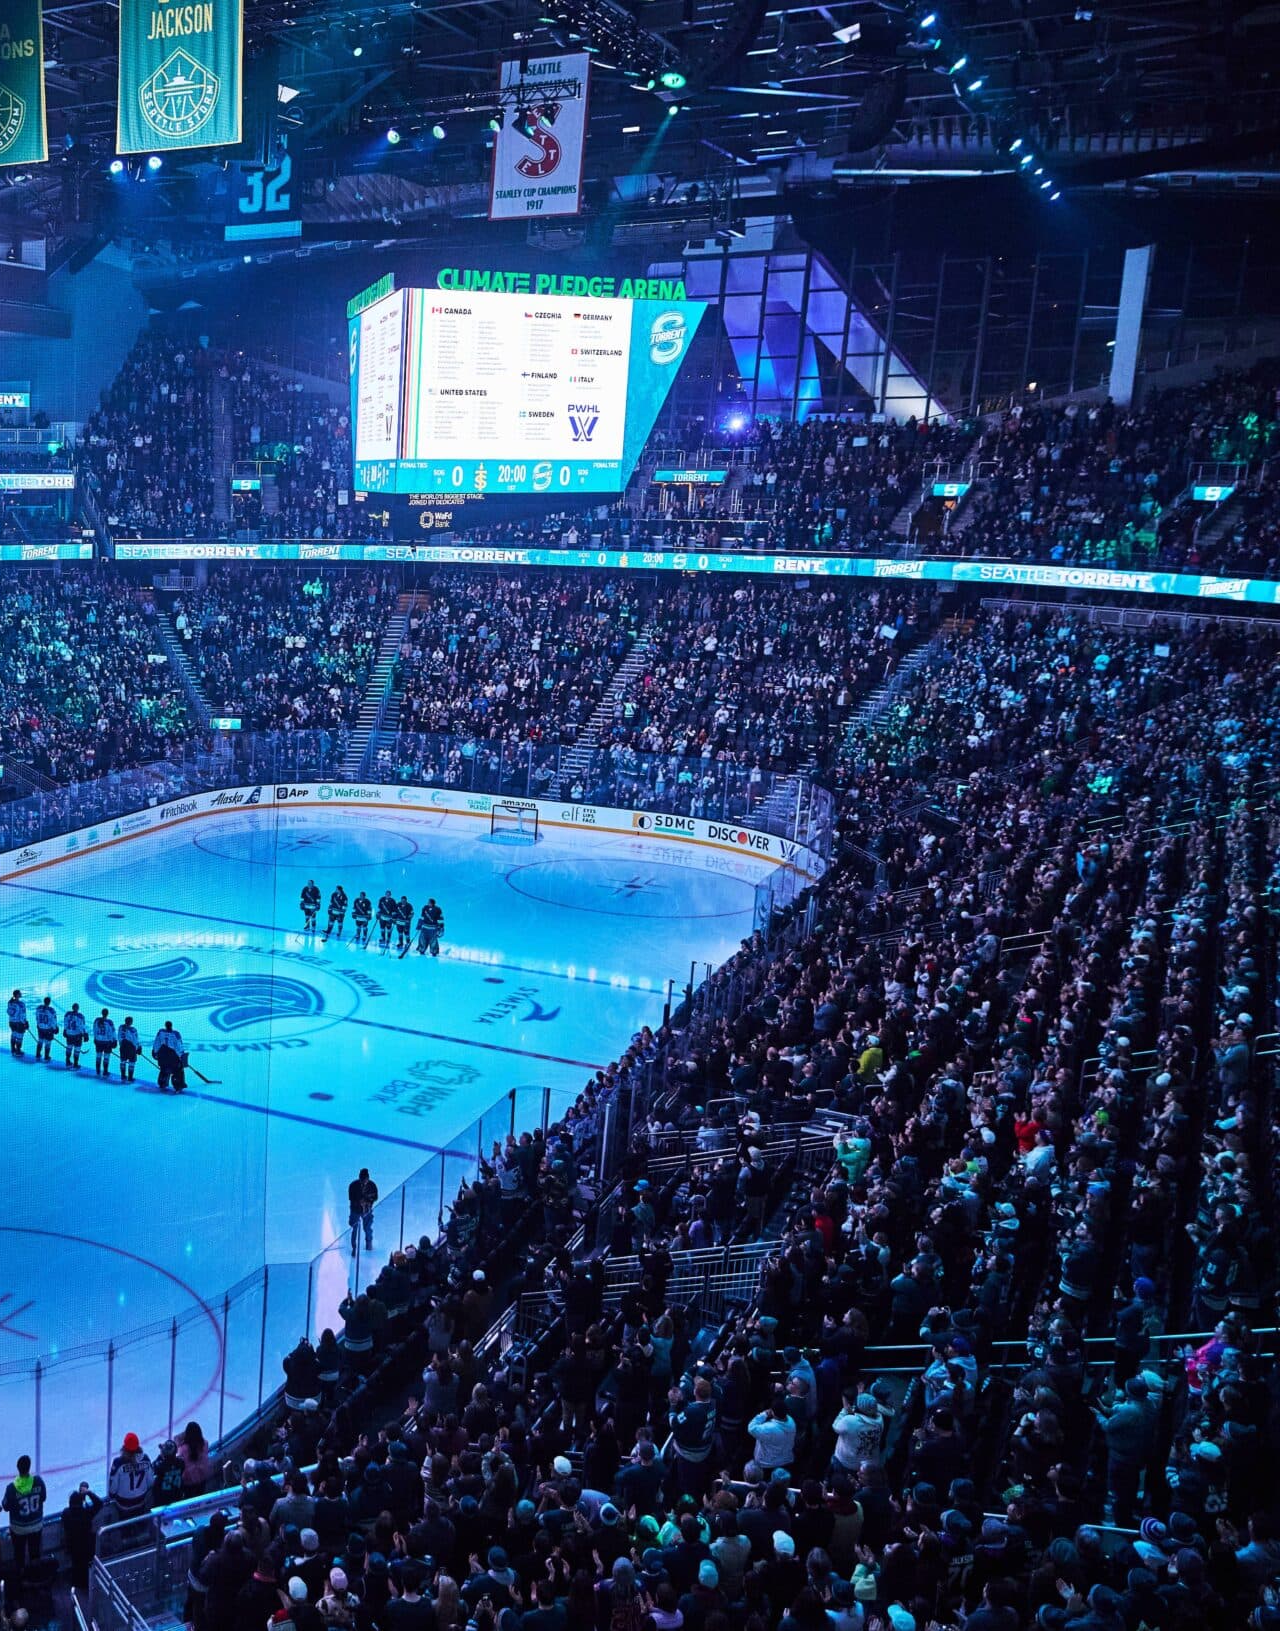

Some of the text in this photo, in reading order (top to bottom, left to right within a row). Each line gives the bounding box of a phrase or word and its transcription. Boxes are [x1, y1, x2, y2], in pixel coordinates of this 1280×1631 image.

[147, 3, 213, 40] JACKSON
[528, 61, 561, 76] SEATTLE
[144, 85, 216, 132] SEATTLE STORM
[239, 154, 292, 214] 32
[496, 184, 577, 200] STANLEY CUP CHAMPIONS
[526, 200, 544, 211] 1917
[437, 268, 688, 301] CLIMATE PLEDGE ARENA
[444, 307, 472, 315] CANADA
[582, 313, 613, 321] GERMANY
[580, 348, 623, 356] SWITZERLAND
[440, 388, 487, 397] UNITED STATES
[568, 404, 600, 413] PWHL
[451, 465, 463, 487] 0
[497, 464, 526, 483] 20:00
[559, 465, 570, 486] 0
[673, 473, 708, 482] TORRENT
[434, 512, 453, 520] WaFd
[22, 545, 58, 559] TORRENT
[123, 546, 257, 557] SEATTLE TORRENT
[300, 545, 341, 559] TORRENT
[386, 548, 526, 561] SEATTLE TORRENT
[598, 553, 606, 565] 0
[642, 553, 664, 563] 20:00
[698, 555, 708, 569] 0
[774, 559, 824, 572] RENT
[875, 561, 923, 577] TORRENT
[980, 566, 1150, 589] SEATTLE TORRENT
[1199, 578, 1251, 597] TORRENT
[210, 791, 244, 808] Alaska
[334, 788, 381, 799] WaFd Bank
[165, 800, 198, 819] PitchBook
[501, 799, 536, 809] amazon
[654, 815, 695, 831] SDMC
[708, 825, 770, 851] DISCOVER
[235, 944, 333, 967] PLEDGE
[334, 967, 389, 998] ARENA
[471, 986, 539, 1027] SYMETRA
[128, 1470, 147, 1492] 17
[19, 1494, 40, 1516] 30
